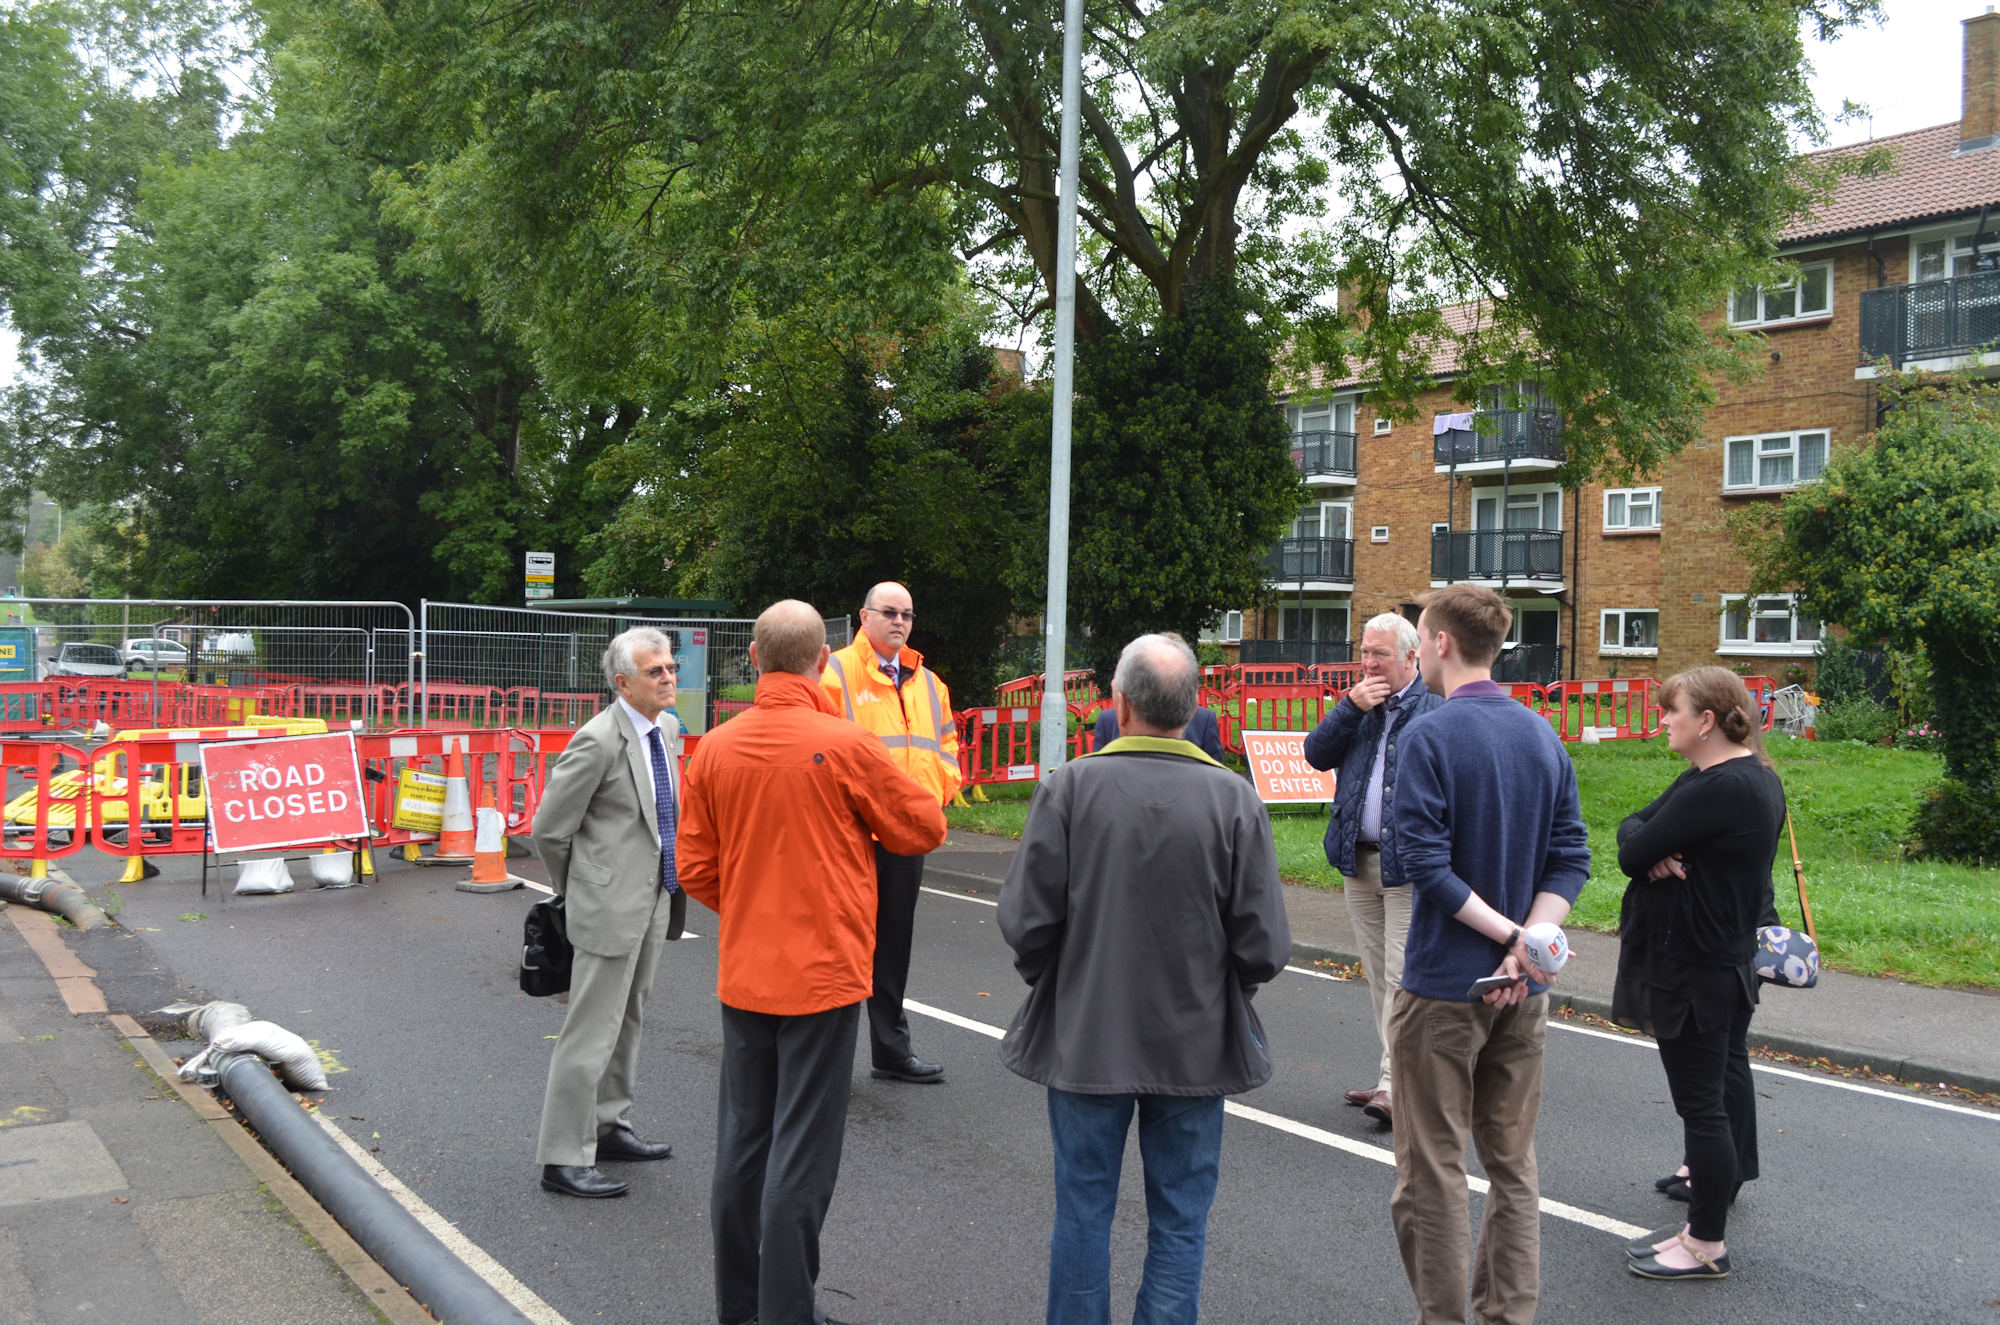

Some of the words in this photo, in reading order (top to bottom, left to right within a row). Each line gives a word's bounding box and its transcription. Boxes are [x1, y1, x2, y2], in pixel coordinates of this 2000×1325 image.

[1252, 741, 1305, 756] DANG
[1260, 759, 1284, 774] DO
[1289, 759, 1323, 775] NO
[240, 763, 325, 792] ROAD
[1269, 778, 1324, 793] ENTER
[225, 790, 348, 823] CLOSED
